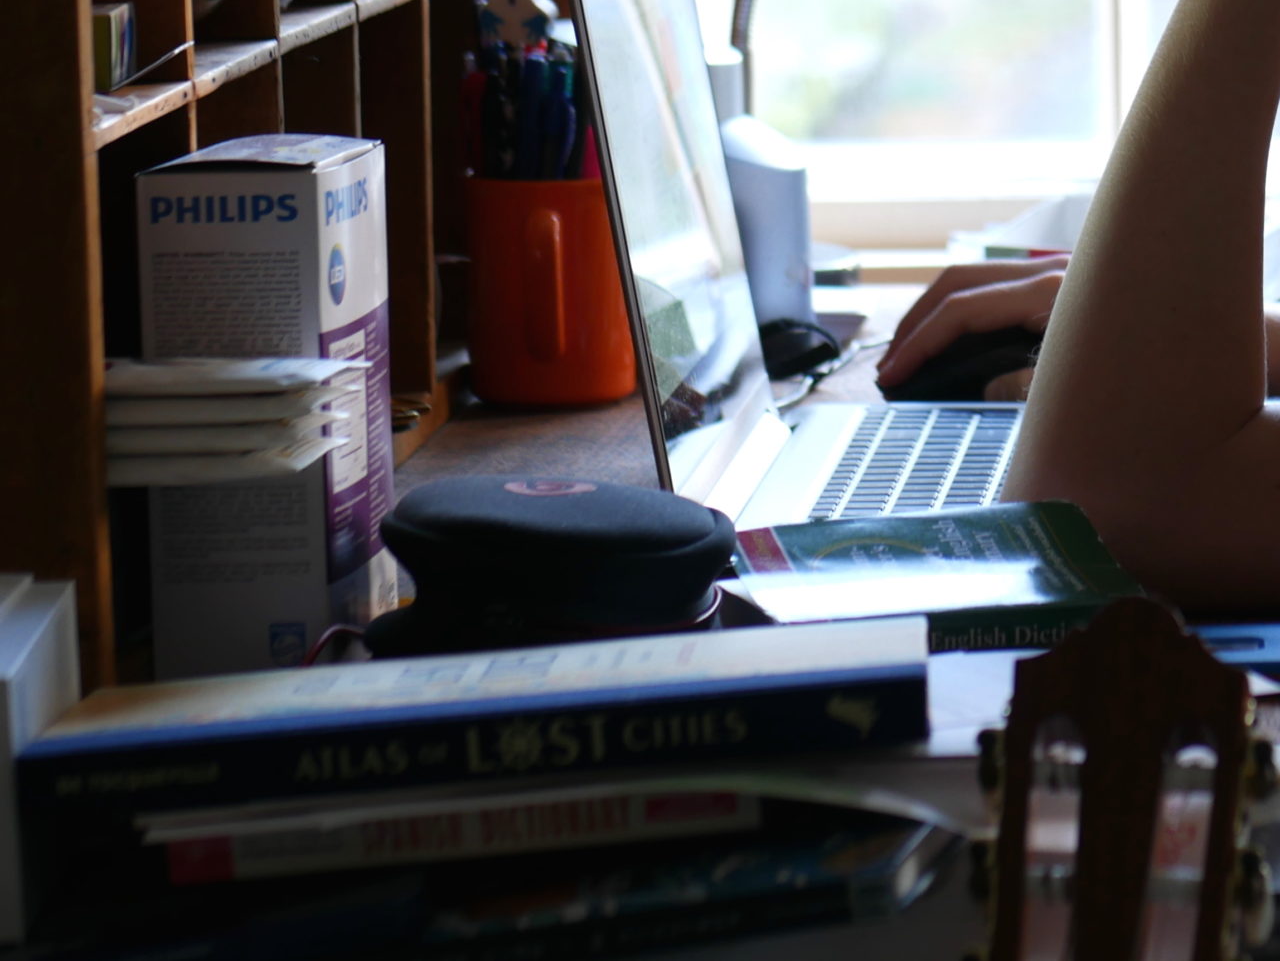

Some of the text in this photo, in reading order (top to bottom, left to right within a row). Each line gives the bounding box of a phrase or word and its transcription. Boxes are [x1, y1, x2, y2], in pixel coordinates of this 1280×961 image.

[150, 194, 298, 224] PHILIPS
[325, 178, 368, 226] PHILIPS
[931, 620, 1068, 651] English Dicti
[293, 738, 410, 783] ATLAS
[464, 712, 611, 776] LOST
[621, 707, 750, 752] CITIES
